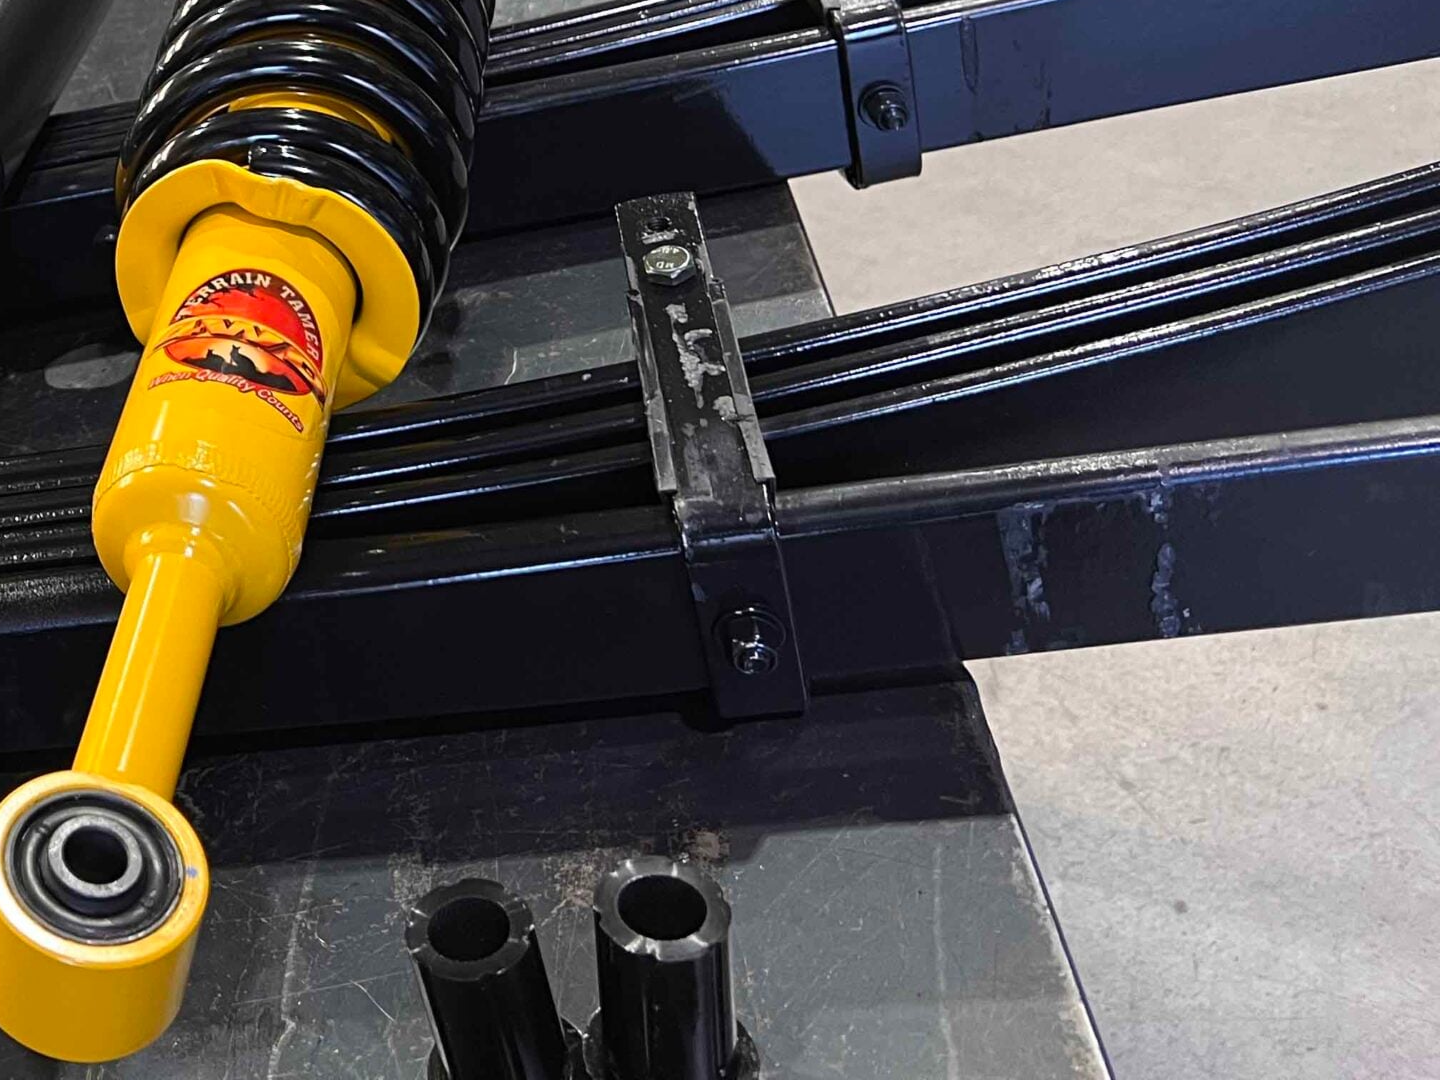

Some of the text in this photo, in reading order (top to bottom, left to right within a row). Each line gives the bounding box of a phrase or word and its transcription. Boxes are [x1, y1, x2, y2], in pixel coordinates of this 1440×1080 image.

[173, 270, 320, 363] TERRAIN TAMER
[195, 367, 258, 394] Quality
[255, 385, 305, 434] Counts
